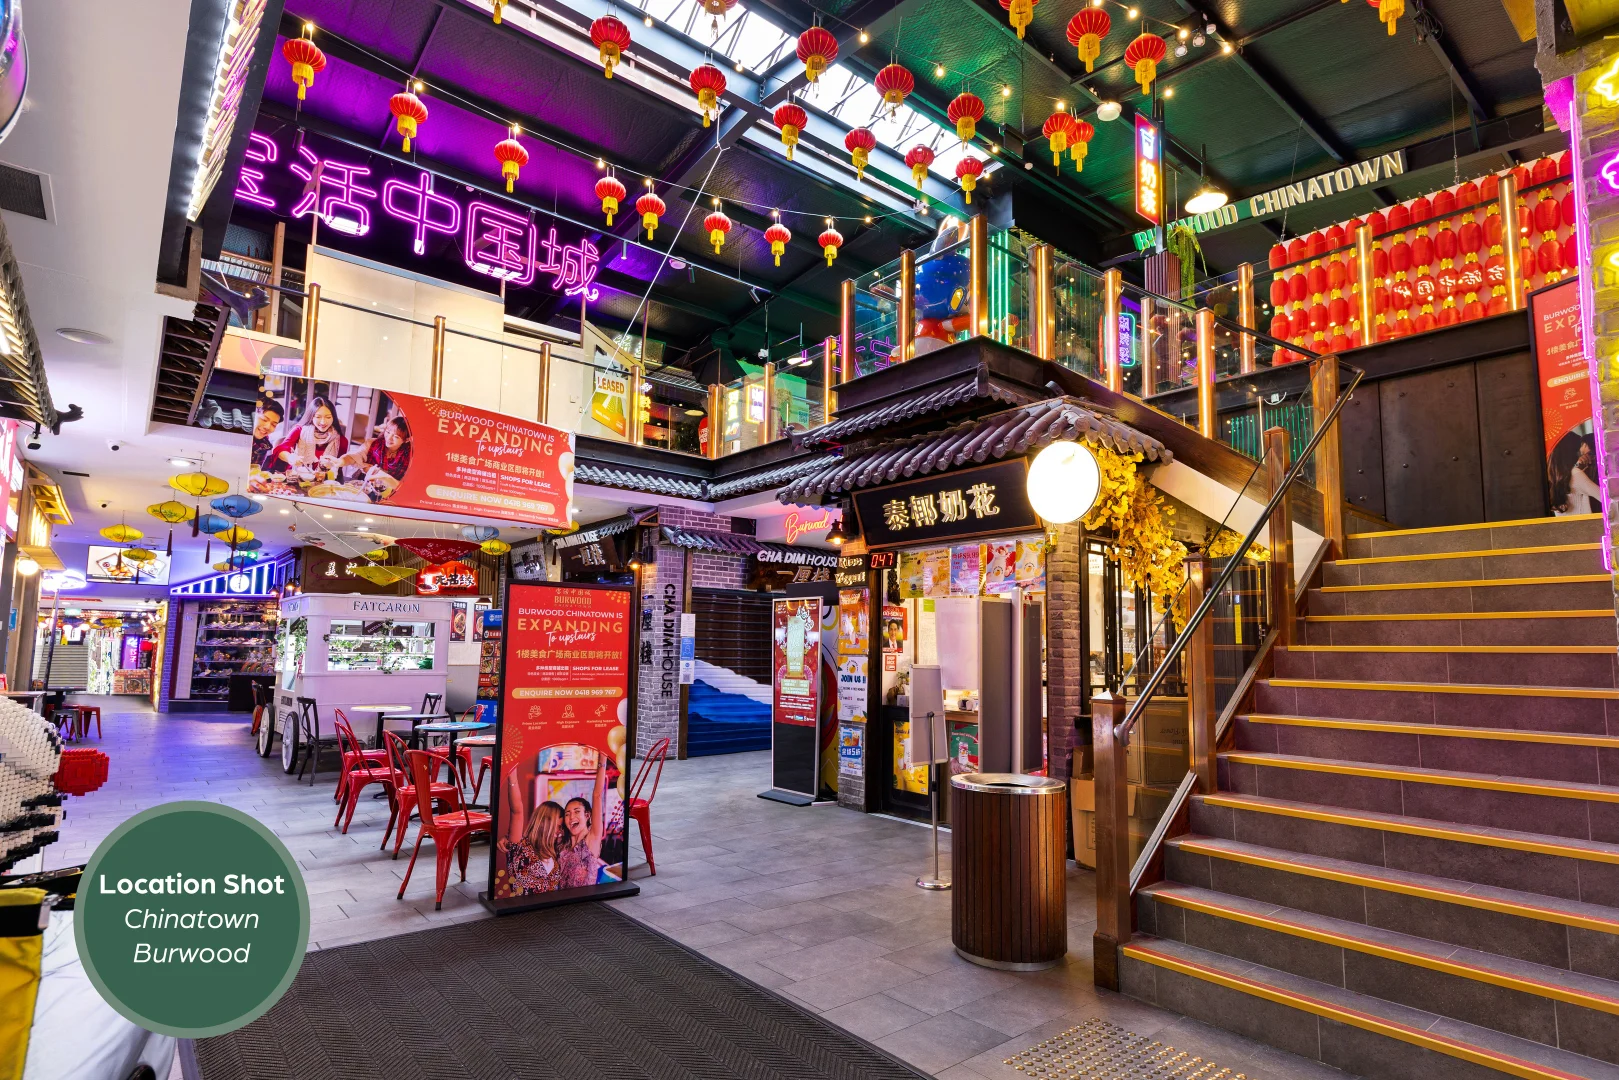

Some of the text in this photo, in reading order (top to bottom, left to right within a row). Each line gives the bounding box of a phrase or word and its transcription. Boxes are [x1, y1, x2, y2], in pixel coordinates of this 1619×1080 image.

[1249, 149, 1404, 218] CHINATOWN
[1544, 304, 1581, 320] BURWOO
[598, 376, 624, 394] LEASED
[1554, 372, 1586, 385] ENQUIRE
[440, 409, 495, 428] BURWOOD
[496, 422, 547, 440] CHINATOWN
[438, 418, 553, 456] EXPANDING
[476, 440, 524, 457] To upstairs
[436, 489, 477, 500] ENQUIRE
[480, 496, 502, 504] NOW
[882, 482, 1000, 530] 泰椰奶花
[786, 511, 830, 544] Burwood
[757, 550, 782, 563] CHA
[784, 552, 805, 564] DIM
[871, 553, 894, 568] 047
[353, 600, 420, 613] FATCARON
[554, 596, 591, 605] BURWOOD
[518, 608, 564, 616] BURWOOD
[518, 618, 622, 633] EXPANDING
[546, 629, 597, 646] To upstairs
[662, 584, 676, 698] CHA DIM HOUSE
[841, 674, 853, 682] JOIN
